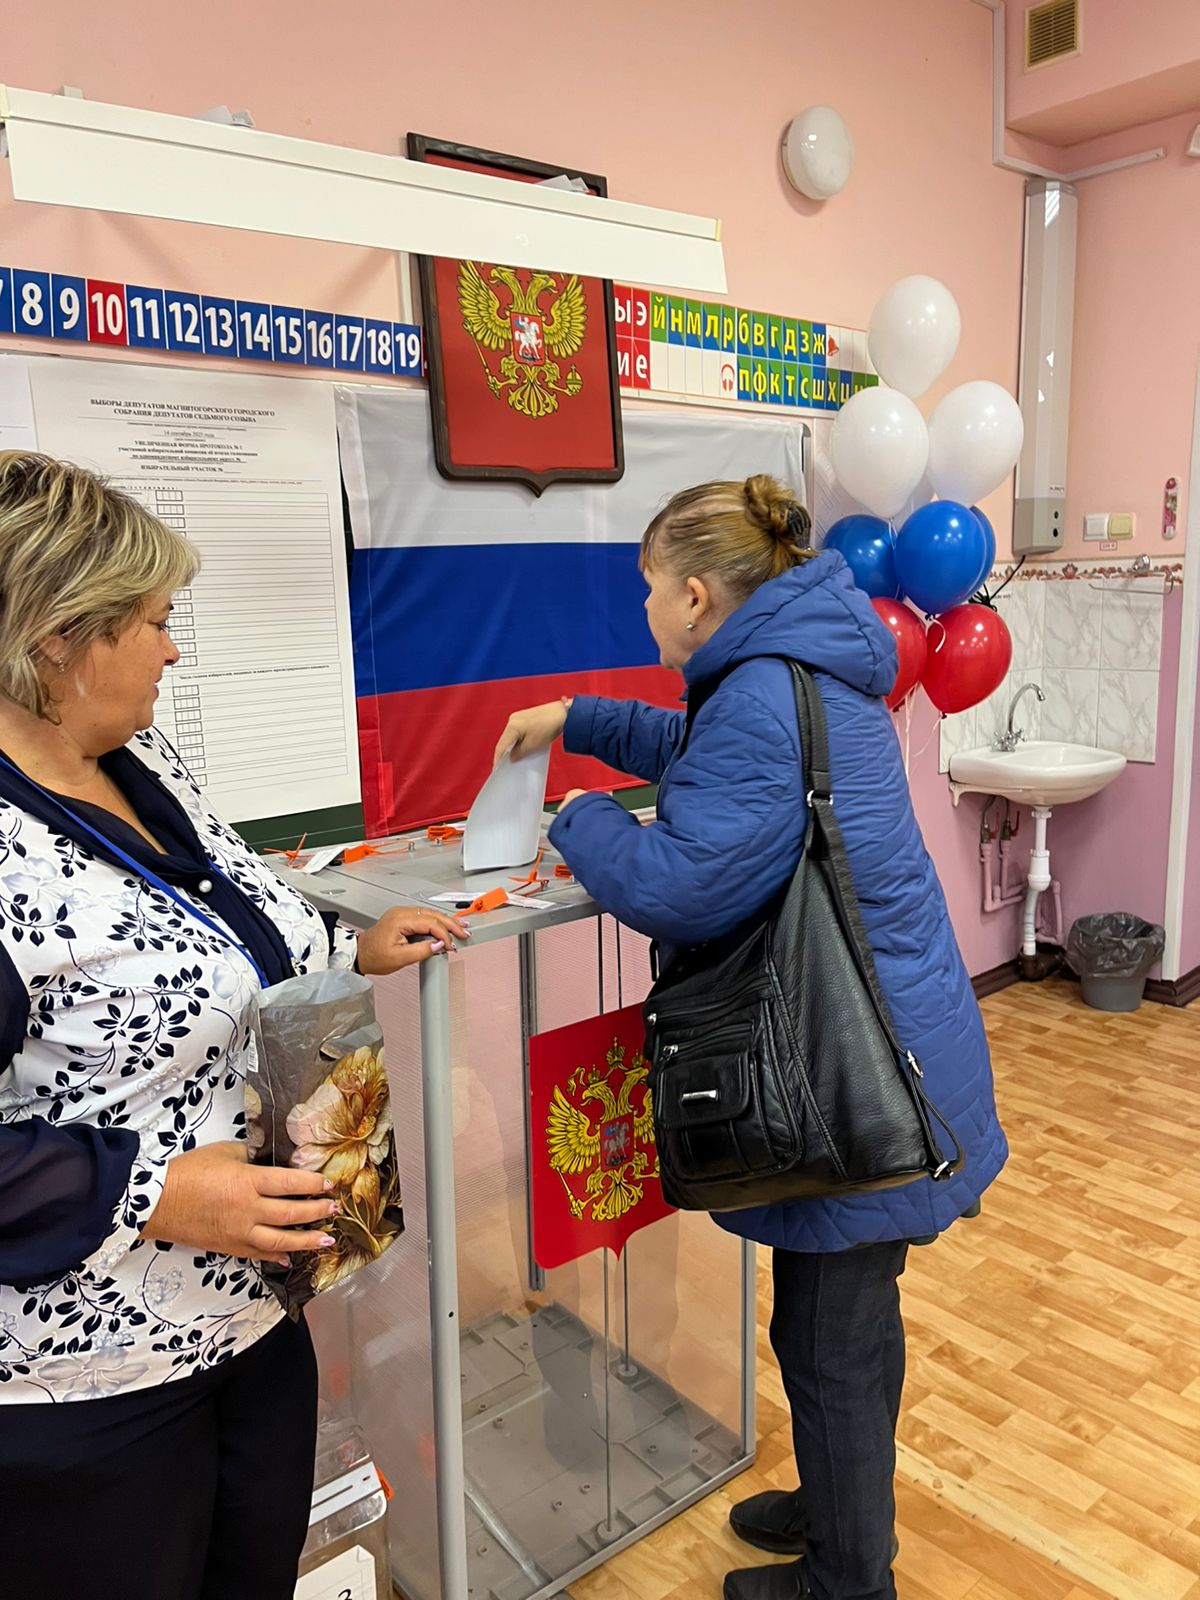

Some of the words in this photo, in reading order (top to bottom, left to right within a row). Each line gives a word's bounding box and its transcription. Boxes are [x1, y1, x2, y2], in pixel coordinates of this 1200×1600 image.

[22, 282, 43, 326] 8
[60, 287, 80, 330] 9
[91, 292, 123, 336] 10
[130, 297, 160, 339] 11
[168, 302, 200, 344] 12
[204, 307, 234, 348] 13
[240, 311, 270, 352] 14
[274, 316, 302, 355] 15
[307, 320, 333, 359] 16
[337, 325, 362, 362] 17
[366, 328, 392, 366] 18
[395, 332, 420, 368] 19
